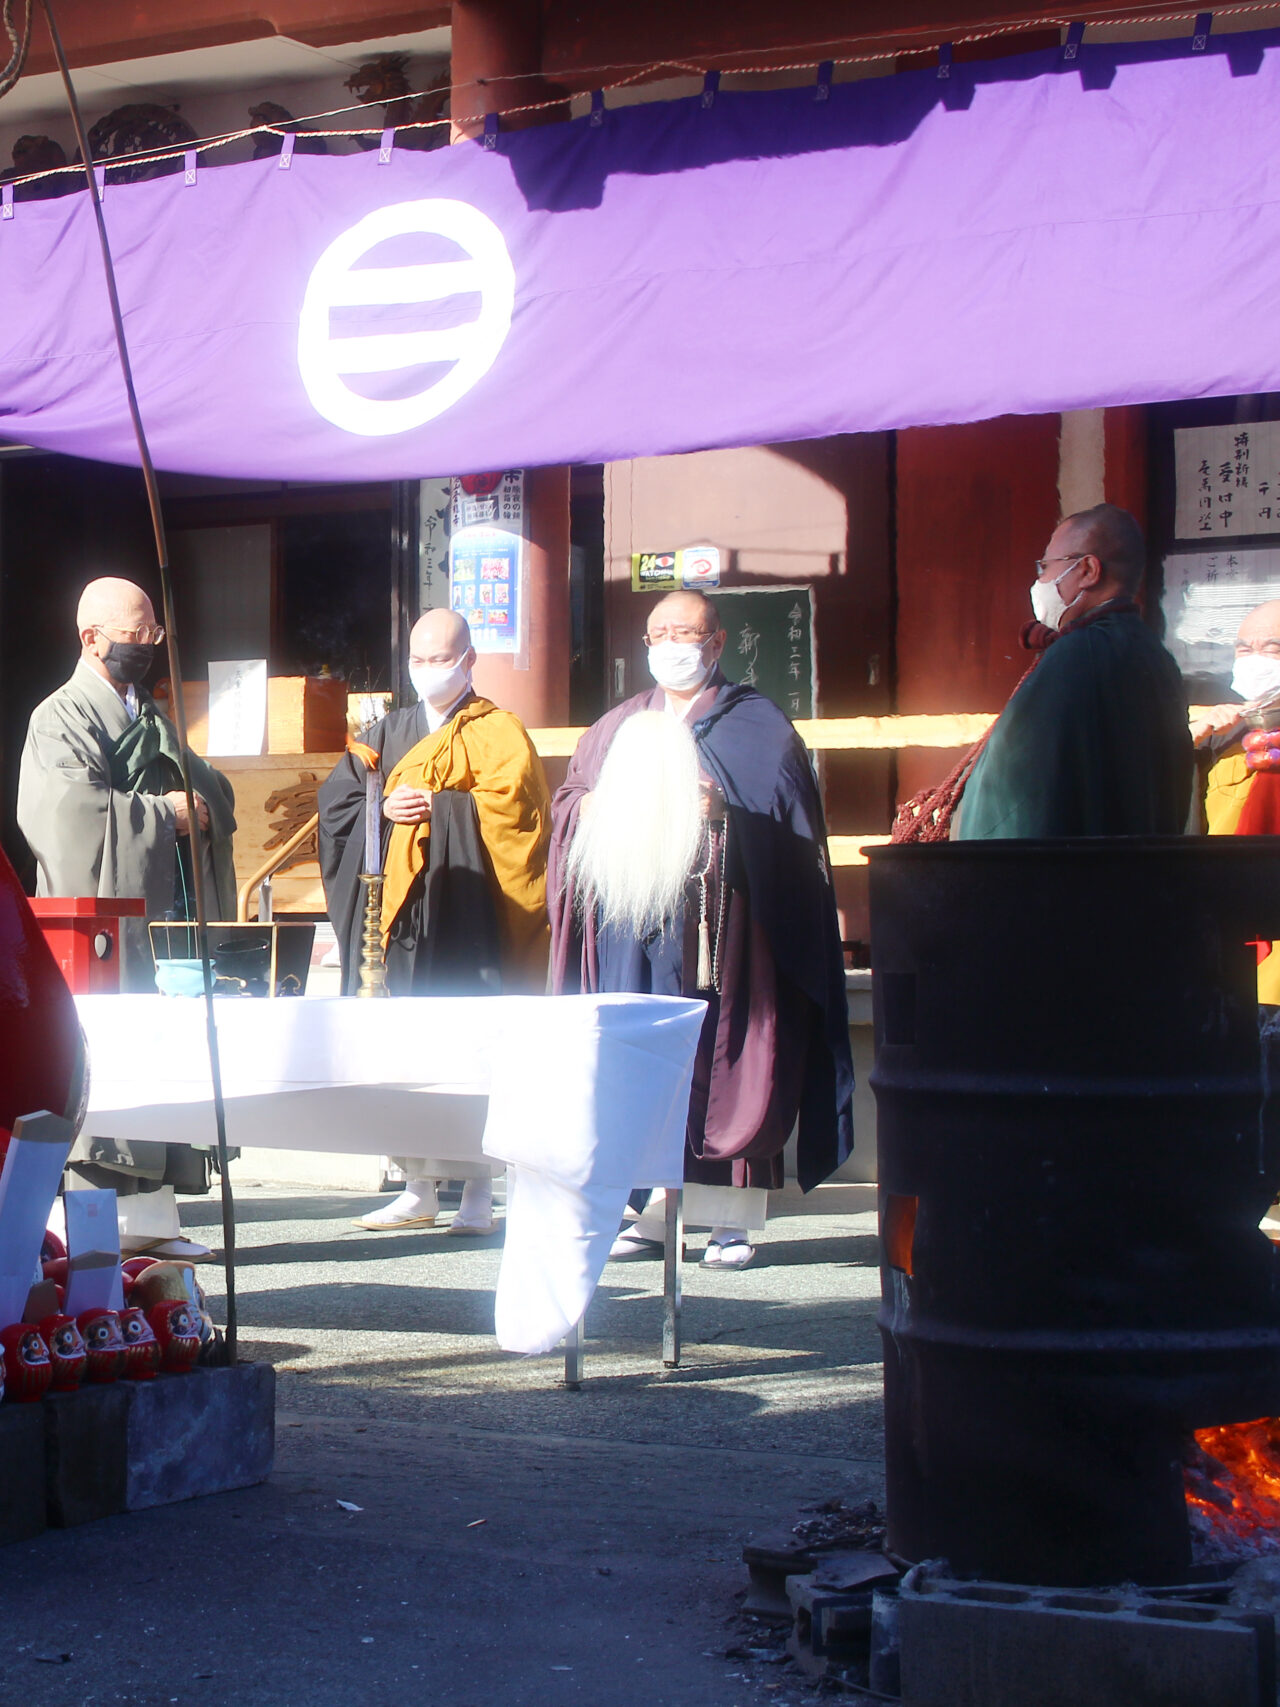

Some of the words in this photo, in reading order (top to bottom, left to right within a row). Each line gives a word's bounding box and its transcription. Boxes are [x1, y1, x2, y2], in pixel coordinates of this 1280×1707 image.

[1218, 462, 1234, 528] 受付中
[640, 554, 657, 571] 24
